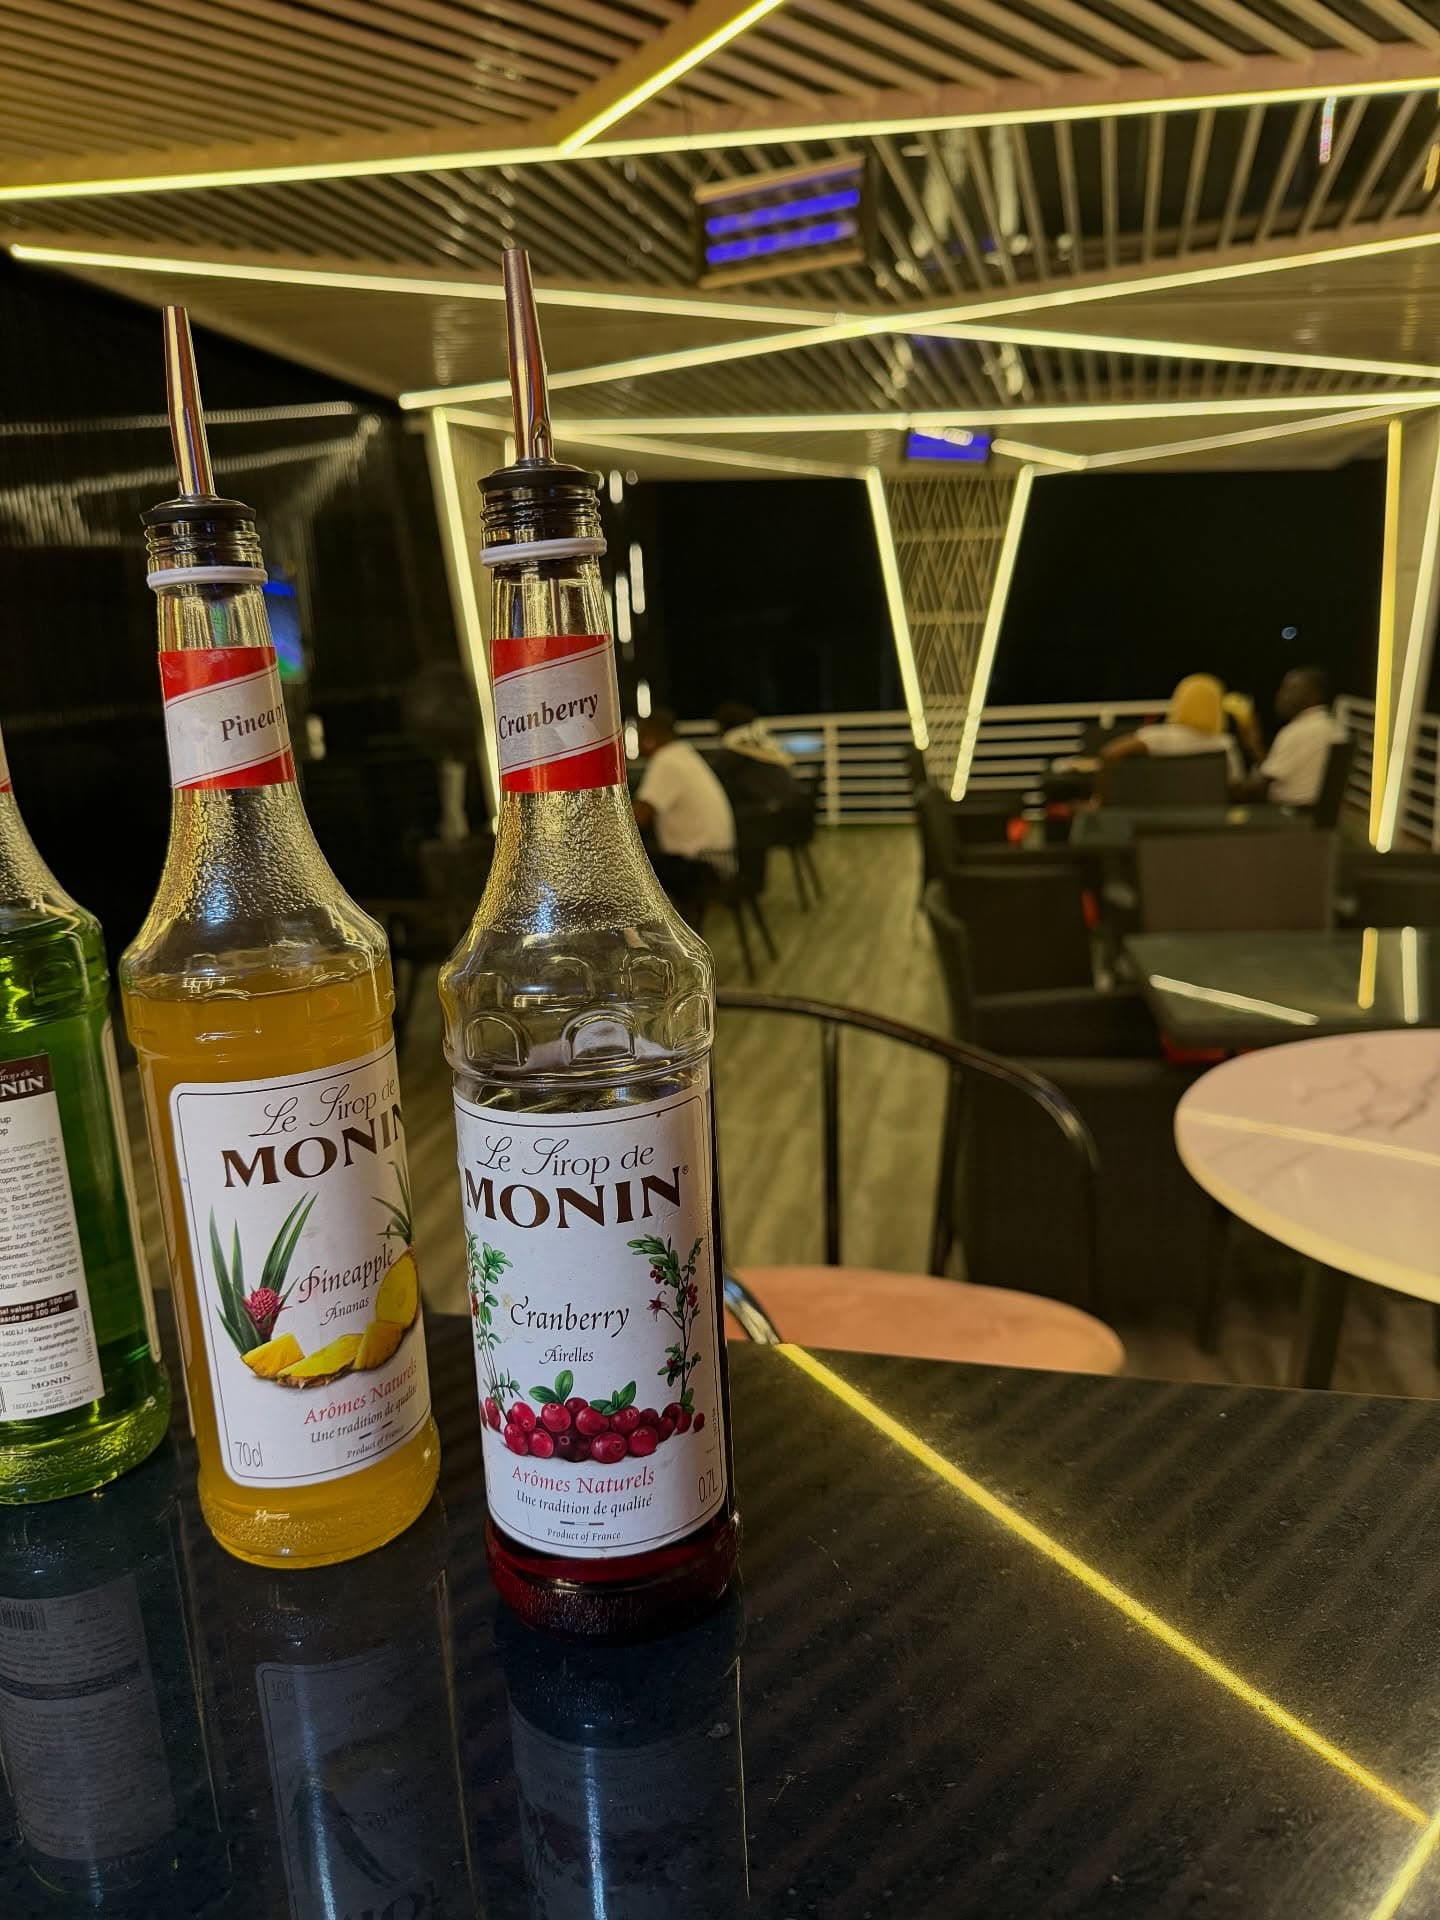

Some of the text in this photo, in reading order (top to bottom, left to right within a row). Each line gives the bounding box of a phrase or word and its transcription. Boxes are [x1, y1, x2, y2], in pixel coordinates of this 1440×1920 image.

[499, 694, 598, 740] Cranberry
[248, 1079, 395, 1137] Le Sirop de
[476, 1135, 654, 1185] Le Sirop de
[298, 1243, 393, 1303] Pineapple
[10, 1304, 34, 1313] values
[320, 1297, 369, 1326] Ananas
[510, 1295, 629, 1338] Cranberry
[539, 1344, 594, 1364] Airelles
[31, 1374, 72, 1390] MONIN
[304, 1395, 366, 1424] Arômes
[311, 1430, 335, 1443] Une
[338, 1410, 382, 1435] tradition
[384, 1401, 394, 1416] de
[234, 1440, 263, 1467] 70cl
[512, 1465, 655, 1494] Arômes Naturels
[516, 1489, 652, 1518] Une tradition de qualité
[547, 1528, 621, 1543] Product of France
